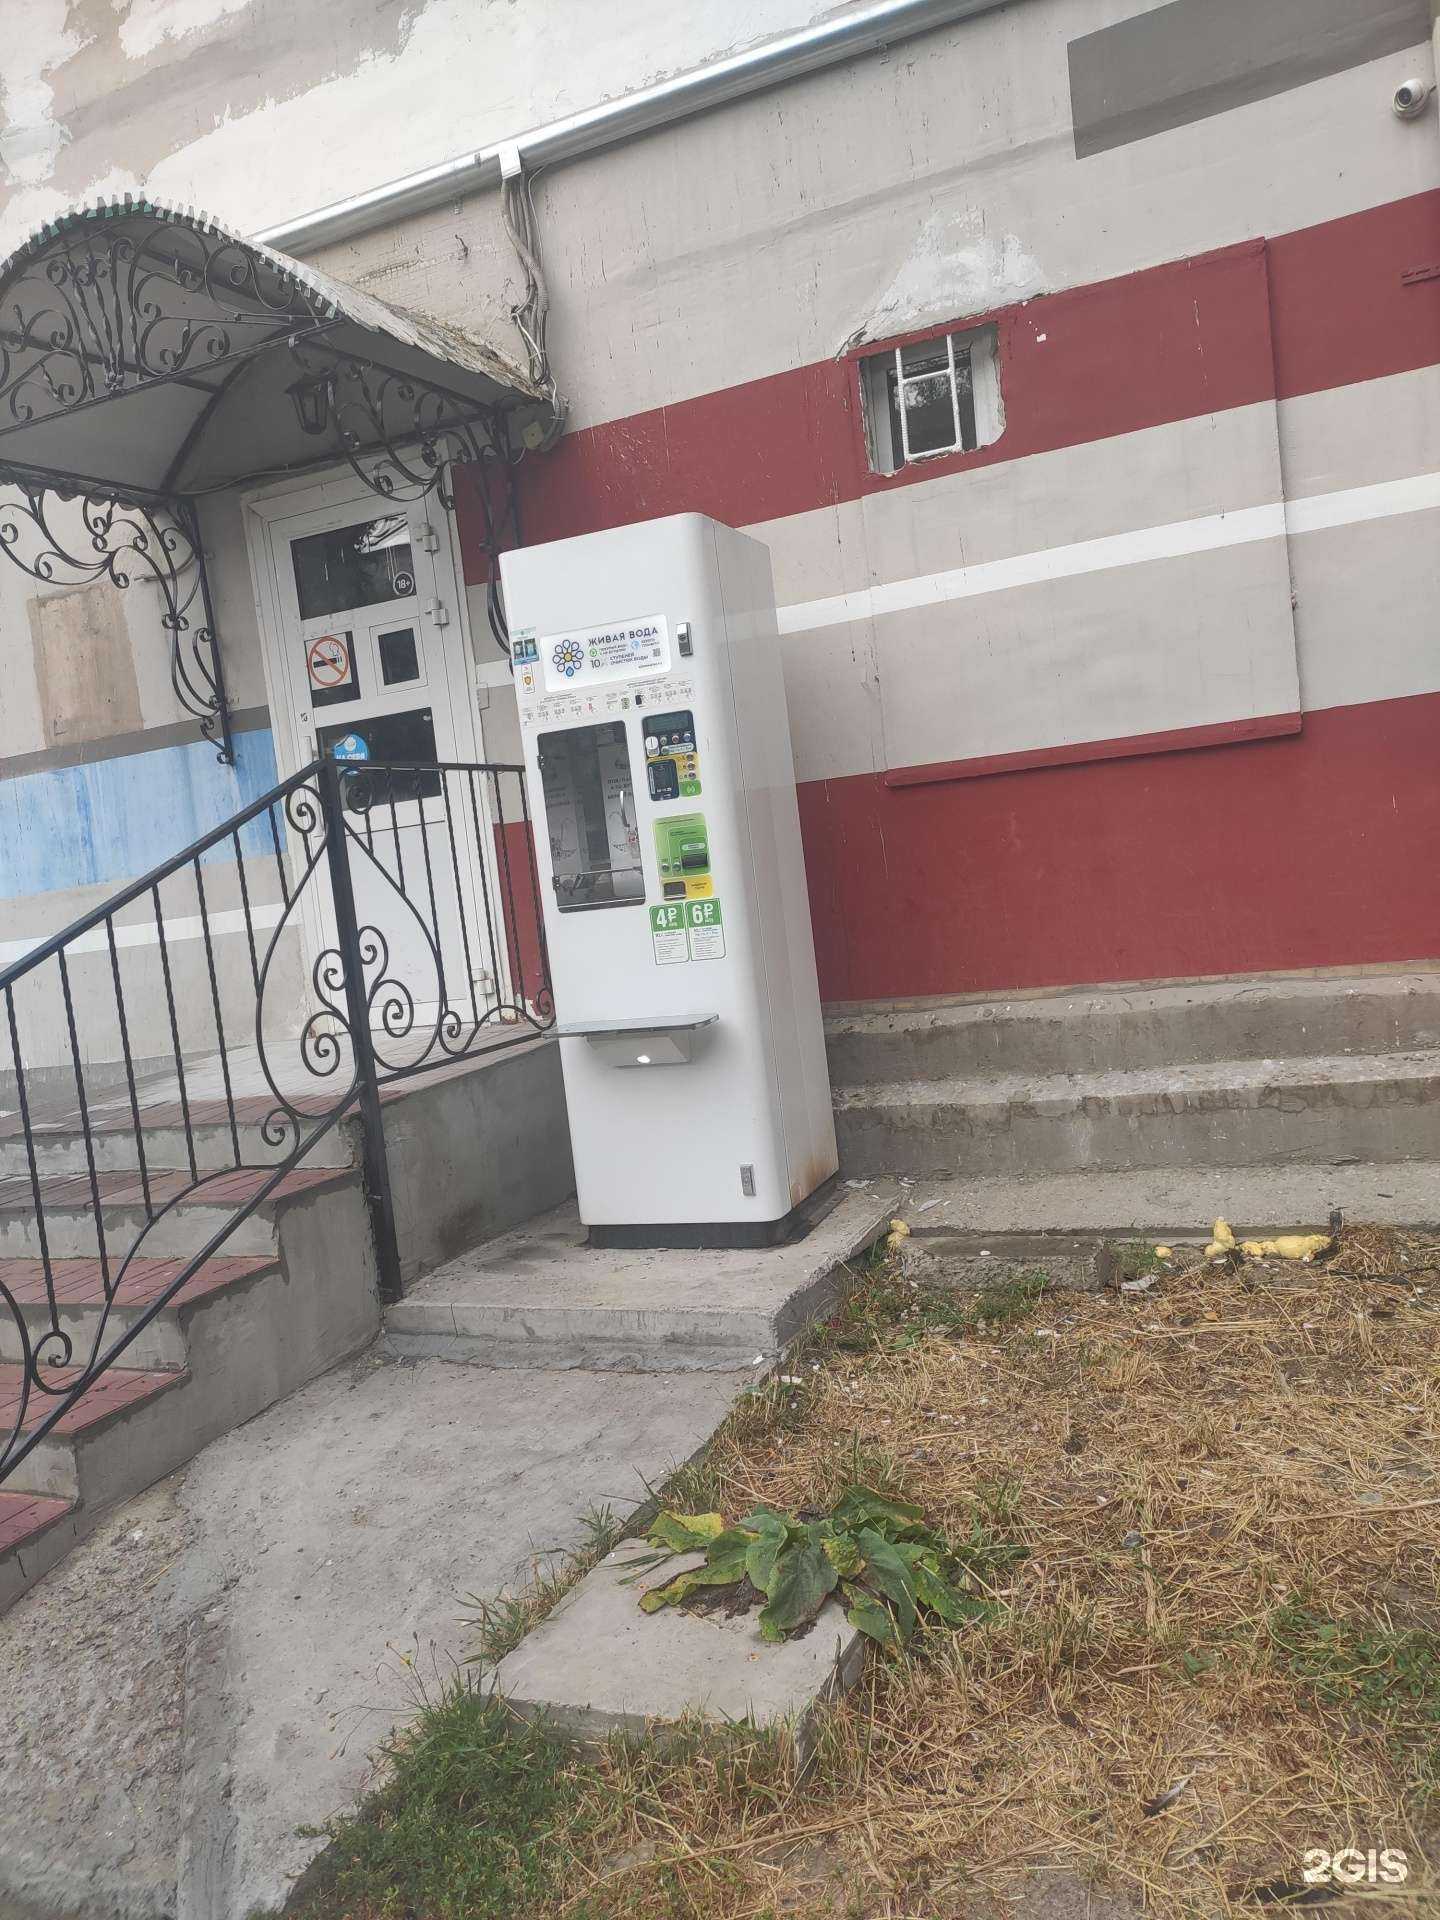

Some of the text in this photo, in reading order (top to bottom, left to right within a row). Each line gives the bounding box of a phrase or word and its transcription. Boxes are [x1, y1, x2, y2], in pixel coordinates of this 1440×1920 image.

[396, 578, 411, 590] 18+
[588, 632, 626, 647] ЖИВАЯ
[628, 626, 659, 639] ВОДА
